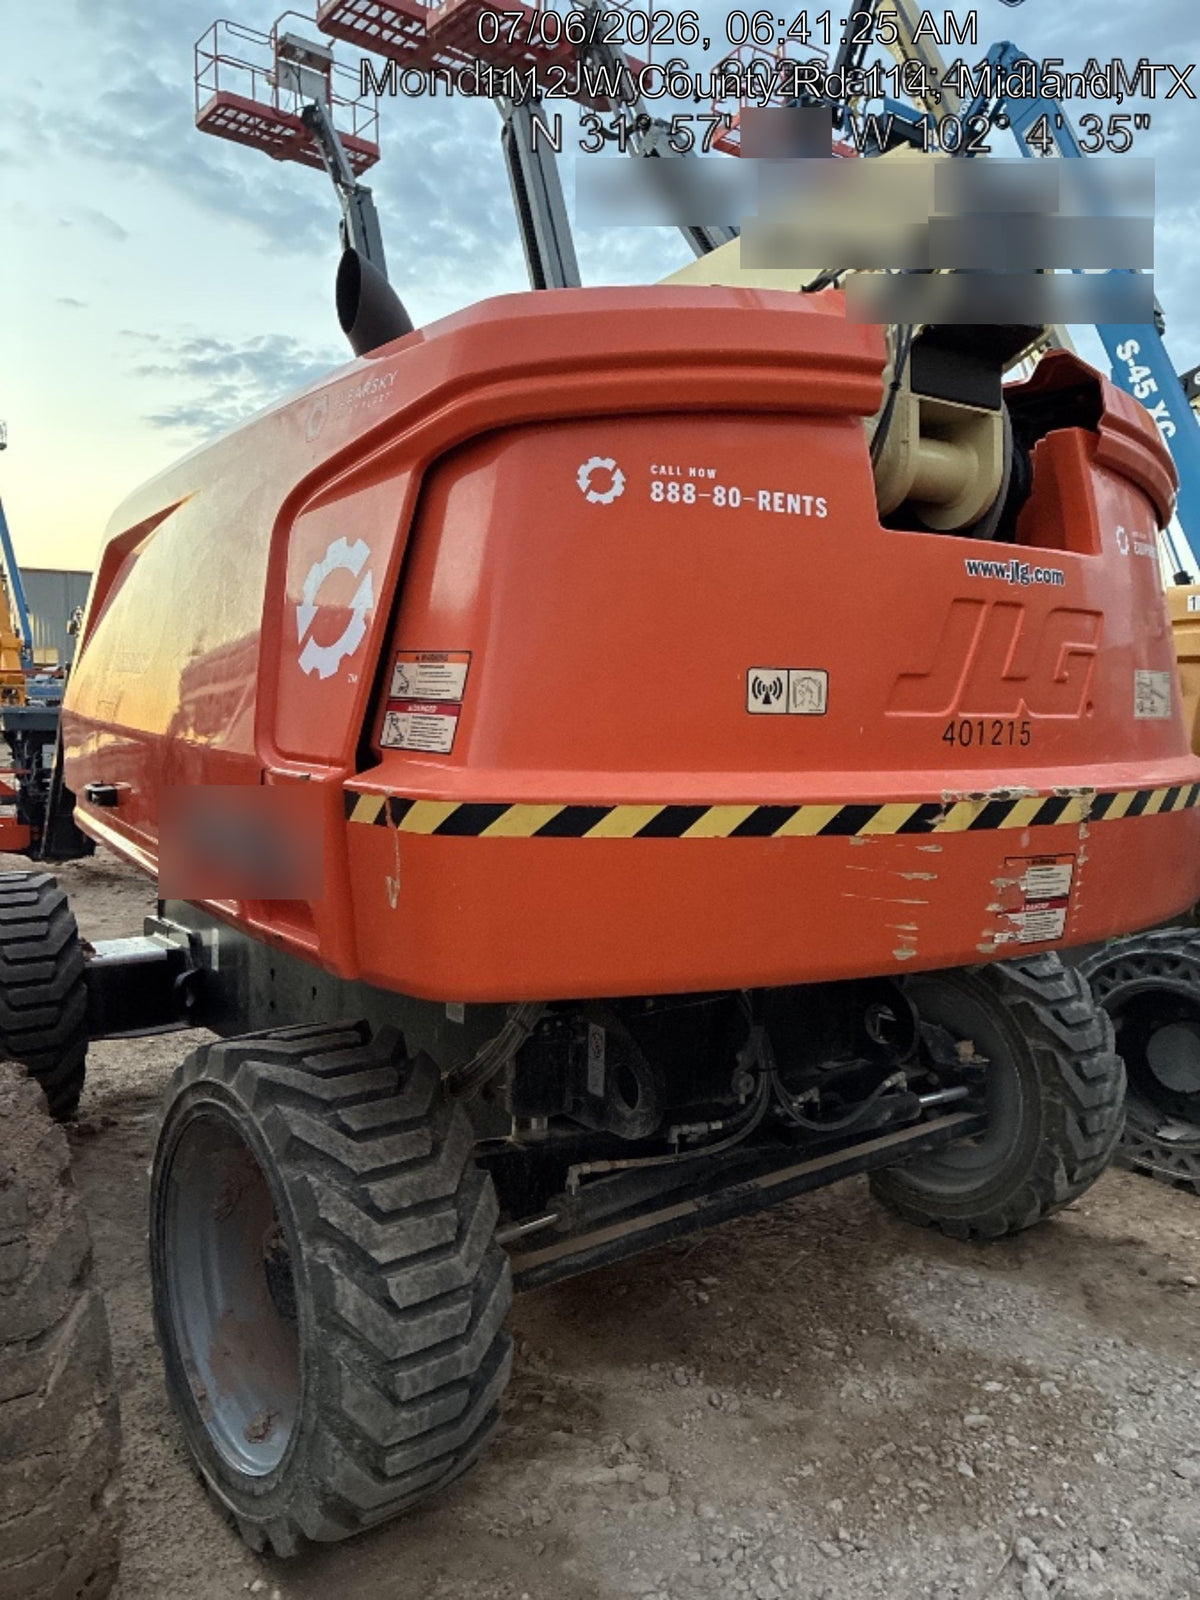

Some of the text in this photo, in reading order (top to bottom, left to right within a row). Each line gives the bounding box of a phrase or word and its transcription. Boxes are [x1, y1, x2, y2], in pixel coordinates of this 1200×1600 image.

[1116, 339, 1158, 399] S-45
[650, 464, 717, 480] CALL NOW
[650, 481, 828, 518] 888-80-RENTS
[964, 558, 1065, 586] www.jlg.com
[941, 719, 1032, 747] 401215
